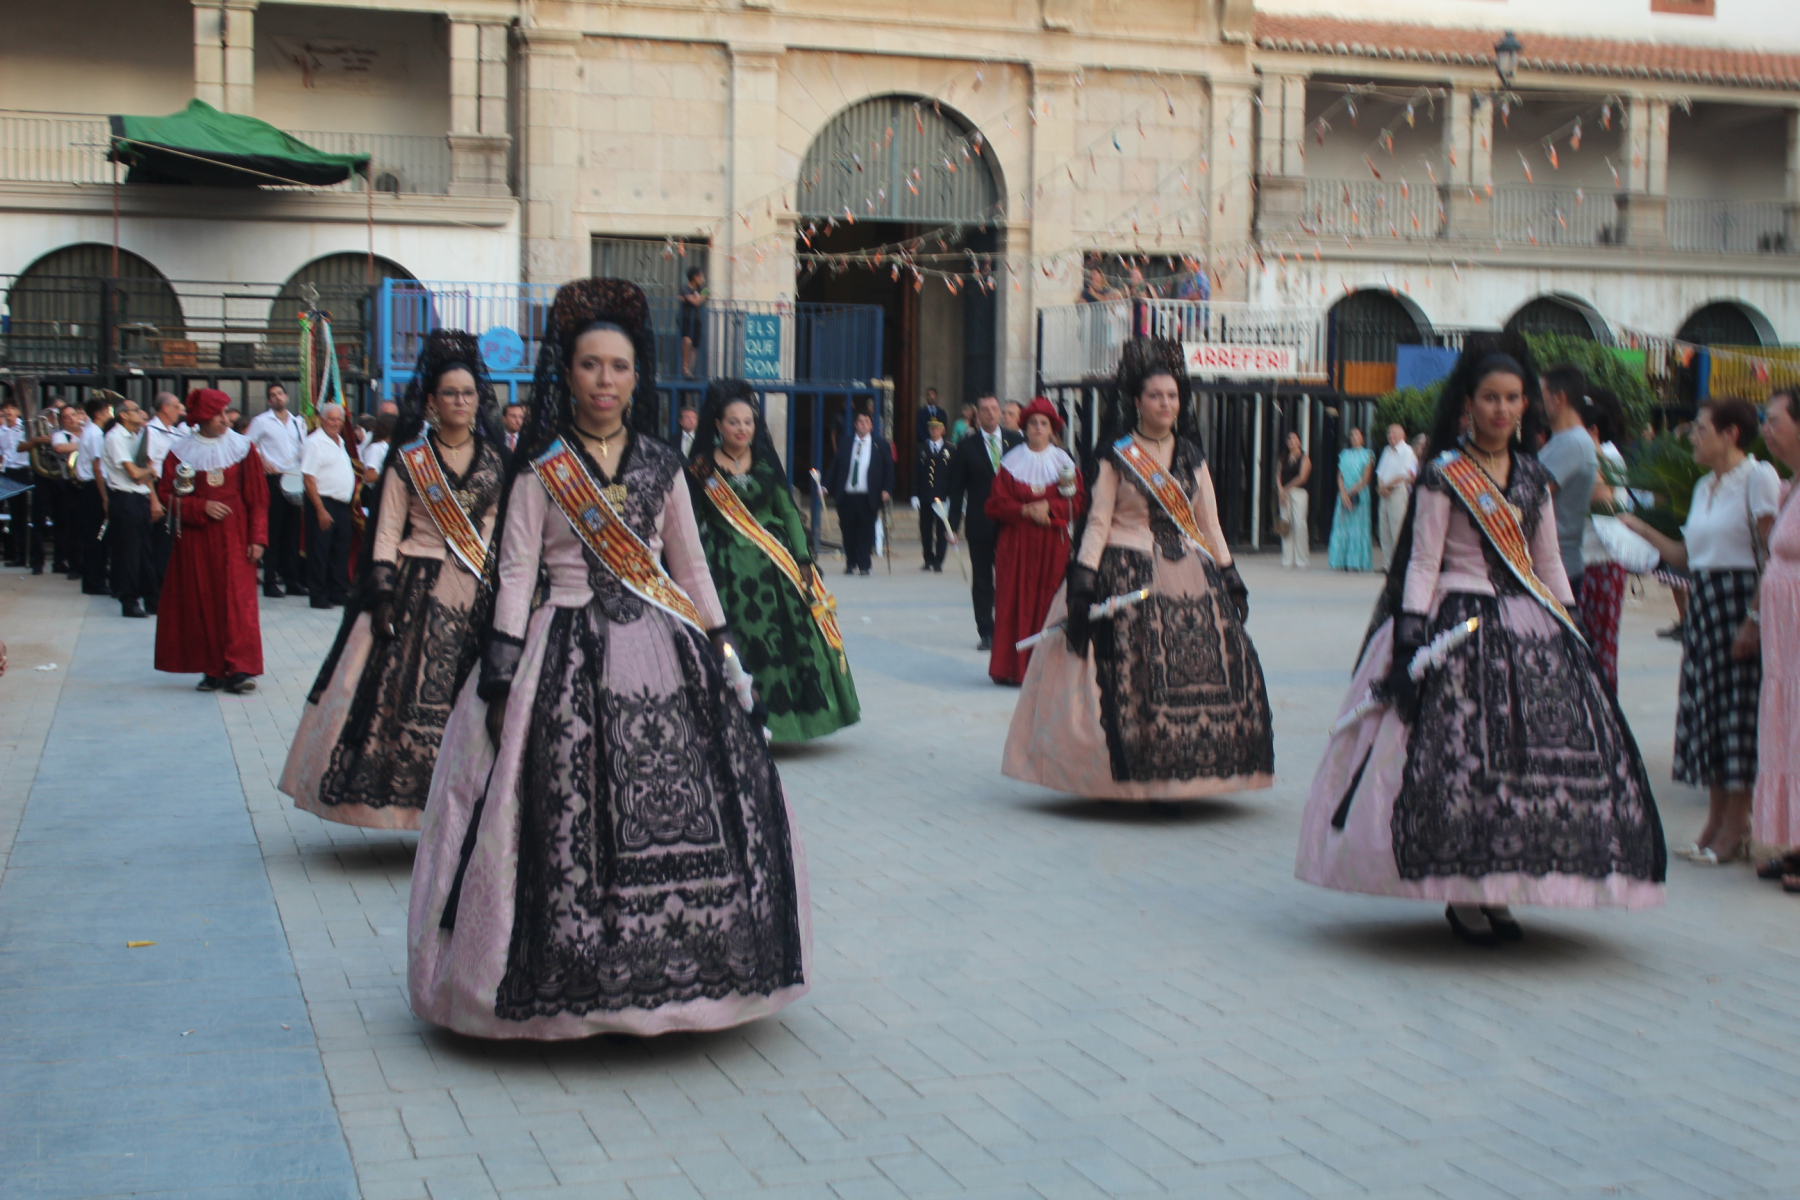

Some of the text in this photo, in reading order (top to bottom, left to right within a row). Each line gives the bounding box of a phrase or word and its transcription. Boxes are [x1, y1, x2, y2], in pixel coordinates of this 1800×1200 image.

[746, 320, 776, 337] ELS
[745, 339, 776, 357] QUE
[745, 358, 780, 377] SOM
